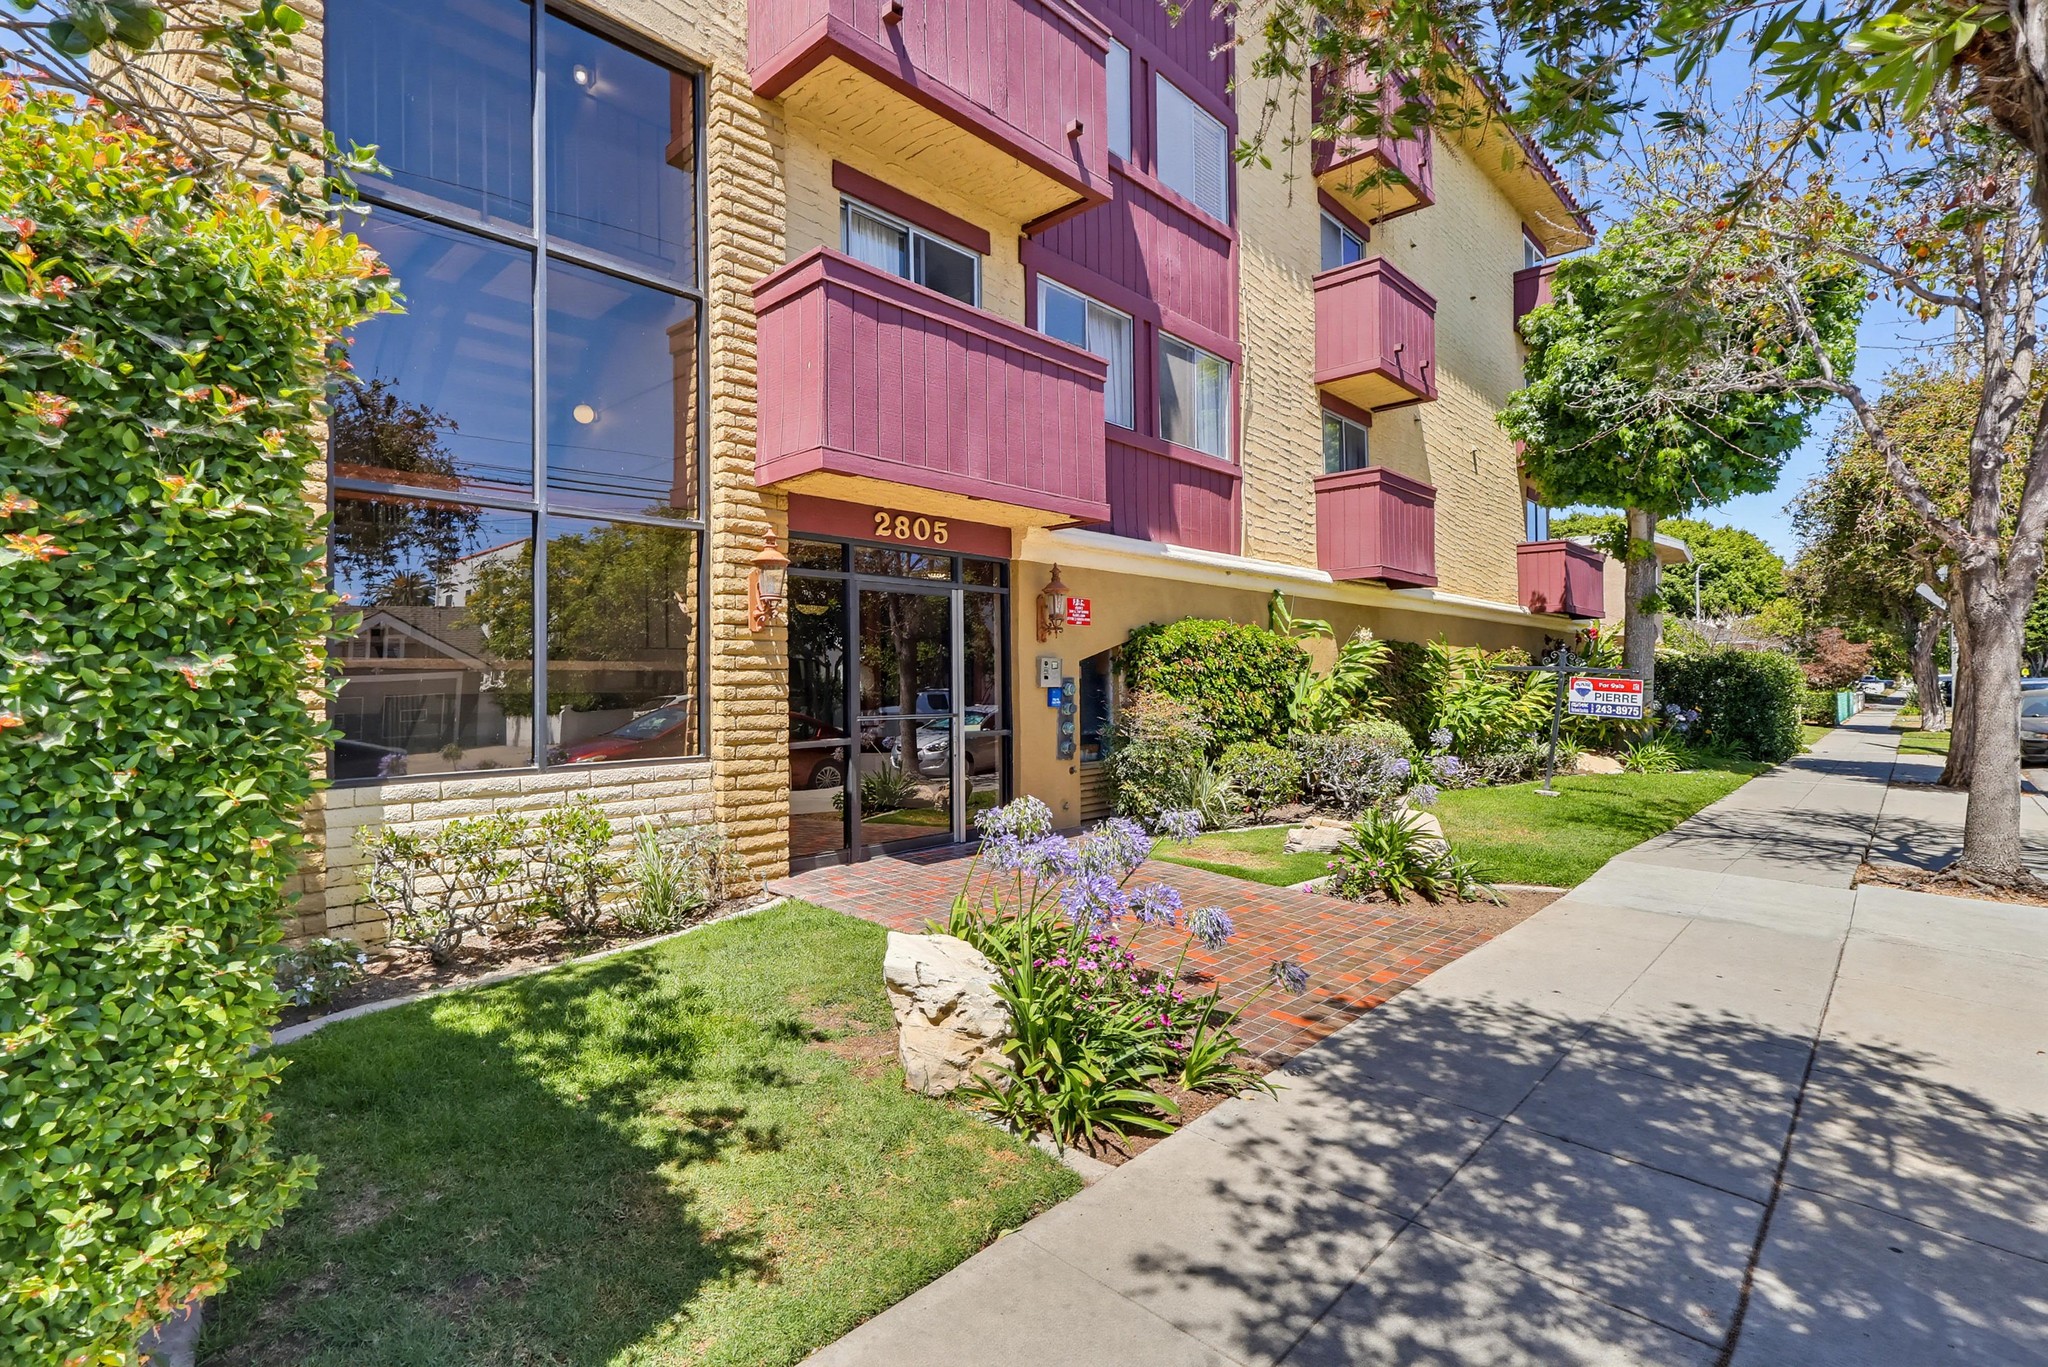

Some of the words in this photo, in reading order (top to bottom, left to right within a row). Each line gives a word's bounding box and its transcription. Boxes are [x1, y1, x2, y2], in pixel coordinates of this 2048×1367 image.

[874, 511, 948, 544] 2805
[1594, 692, 1638, 704] PIERRE
[1595, 704, 1640, 716] 243-8975
